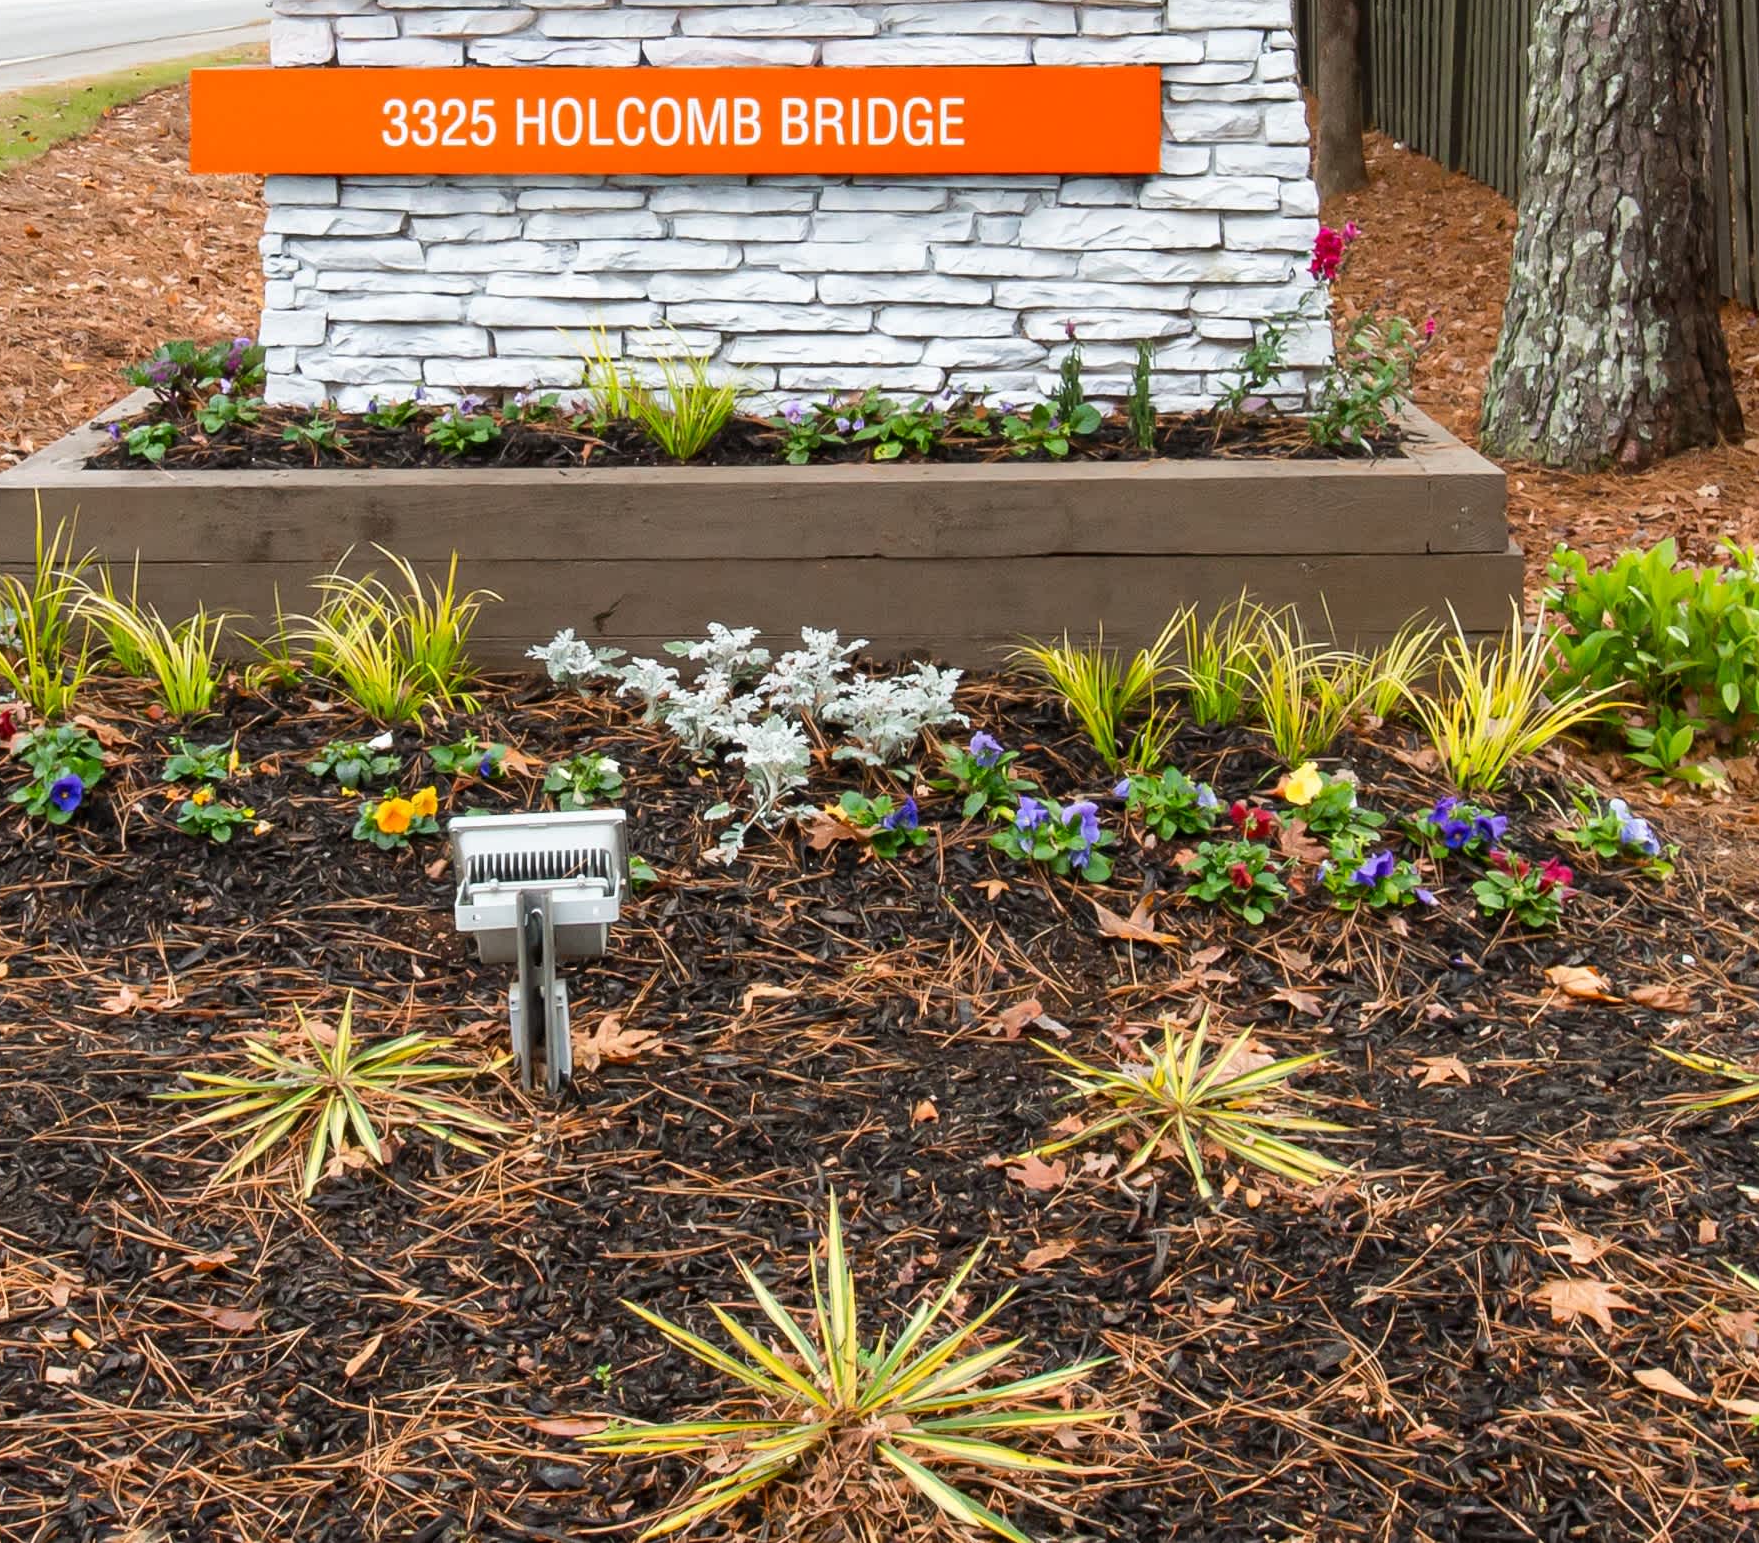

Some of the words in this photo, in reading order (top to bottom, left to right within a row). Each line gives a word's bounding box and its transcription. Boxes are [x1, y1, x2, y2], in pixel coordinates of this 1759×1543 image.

[382, 97, 497, 147] 3325
[516, 97, 762, 147] HOLCOMB
[781, 97, 965, 147] BRIDGE
